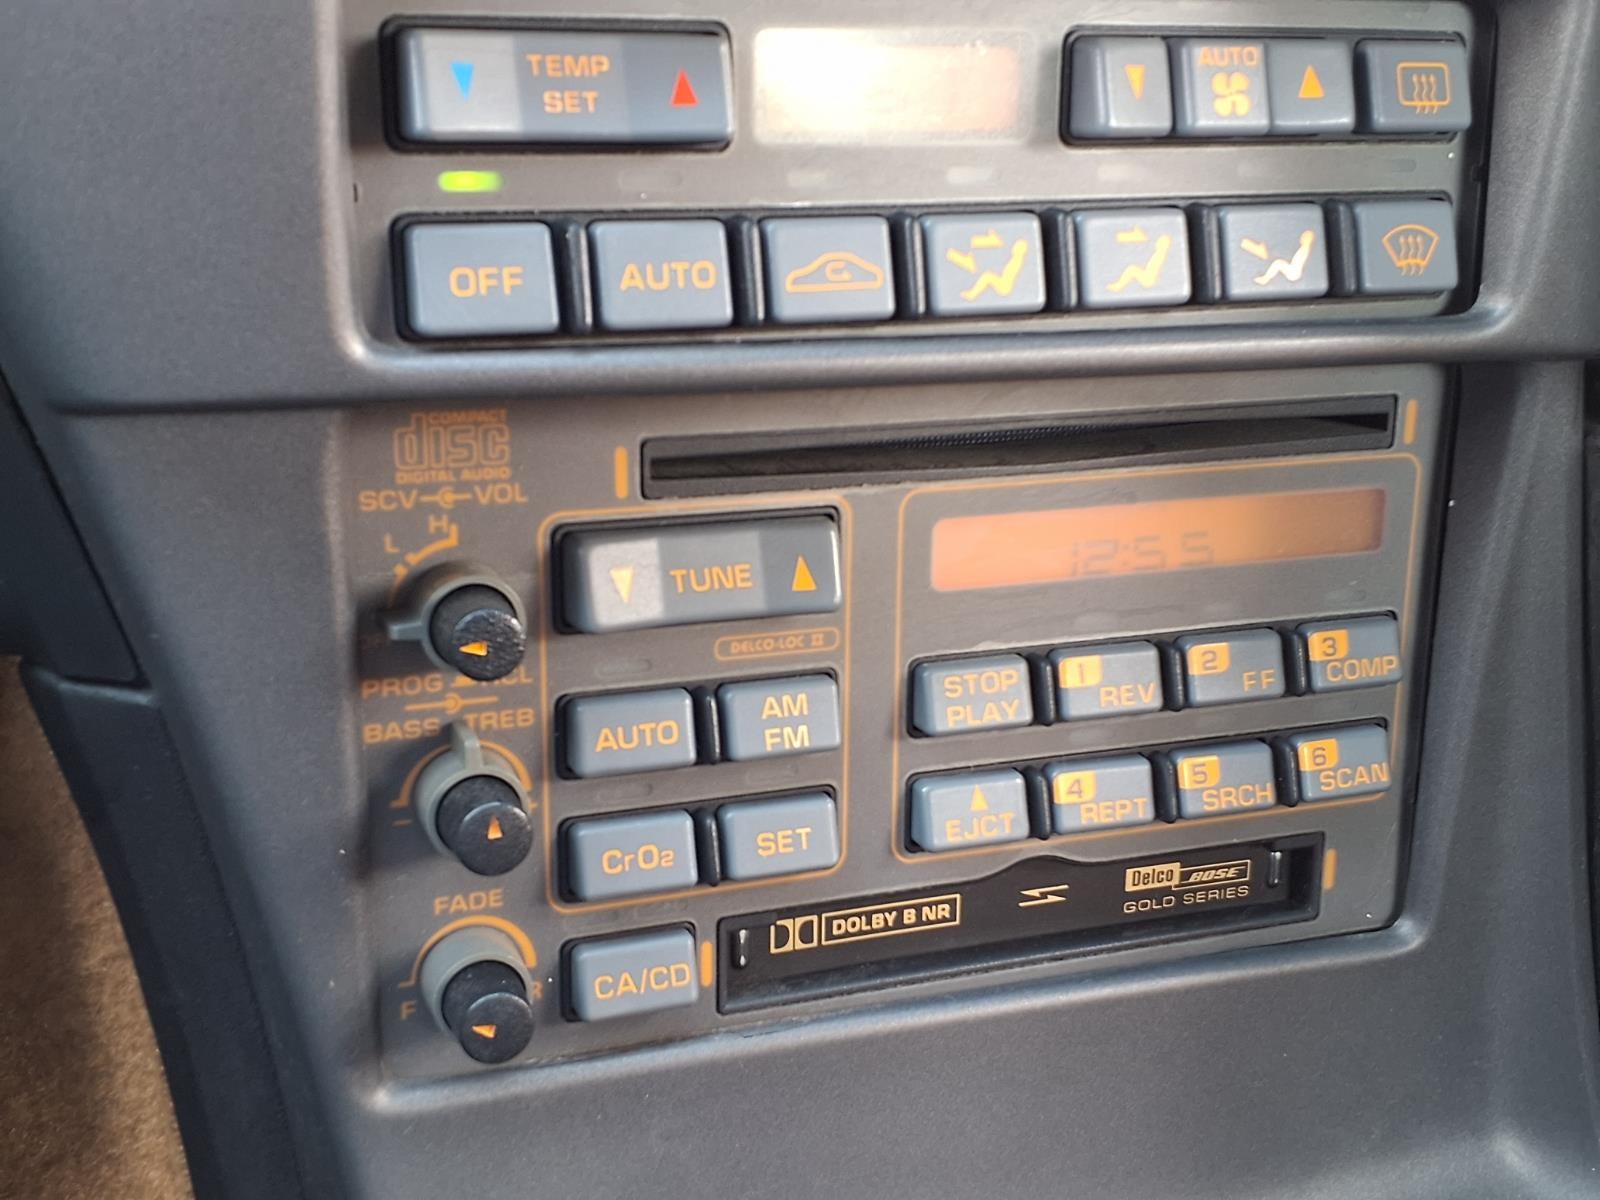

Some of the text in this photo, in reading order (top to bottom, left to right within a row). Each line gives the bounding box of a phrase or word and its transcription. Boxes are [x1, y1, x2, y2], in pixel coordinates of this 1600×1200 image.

[526, 53, 610, 78] TEMP
[1199, 46, 1260, 67] AUTO
[543, 90, 598, 114] SET
[449, 266, 524, 299] OFF
[620, 259, 717, 291] AUTO
[428, 409, 508, 425] COMPACT
[395, 466, 512, 485] DIGITAL AUDIO
[358, 484, 528, 511] SCV VOL
[428, 514, 449, 534] H
[384, 532, 399, 552] L
[669, 563, 753, 593] TUNE
[1201, 650, 1218, 669] 2
[1322, 636, 1338, 657] 3
[1077, 665, 1087, 683] 1
[1242, 669, 1276, 693] FF
[1326, 654, 1398, 683] COMP
[361, 673, 444, 699] PROG
[944, 670, 1019, 699] STOP
[1099, 682, 1157, 708] REV
[761, 693, 809, 720] AM
[946, 698, 1021, 728] PLAY
[362, 707, 535, 744] BASS TREB
[595, 719, 680, 752] AUTO
[764, 724, 811, 751] FM
[1311, 745, 1328, 767] 6
[1064, 777, 1083, 799] 4
[1192, 763, 1208, 786] 5
[1319, 761, 1390, 790] SCAN
[1202, 781, 1275, 811] SRCH
[1080, 797, 1148, 825] REPT
[945, 812, 1016, 843] EJCT
[755, 826, 813, 858] SET
[1131, 867, 1175, 887] Delco
[1182, 866, 1245, 884] BOSE
[433, 888, 505, 916] FADE
[1123, 885, 1250, 914] GOLD SERIES
[831, 903, 951, 936] DOLBY B NR
[593, 961, 692, 1000] CA/CD
[401, 1000, 417, 1020] F
